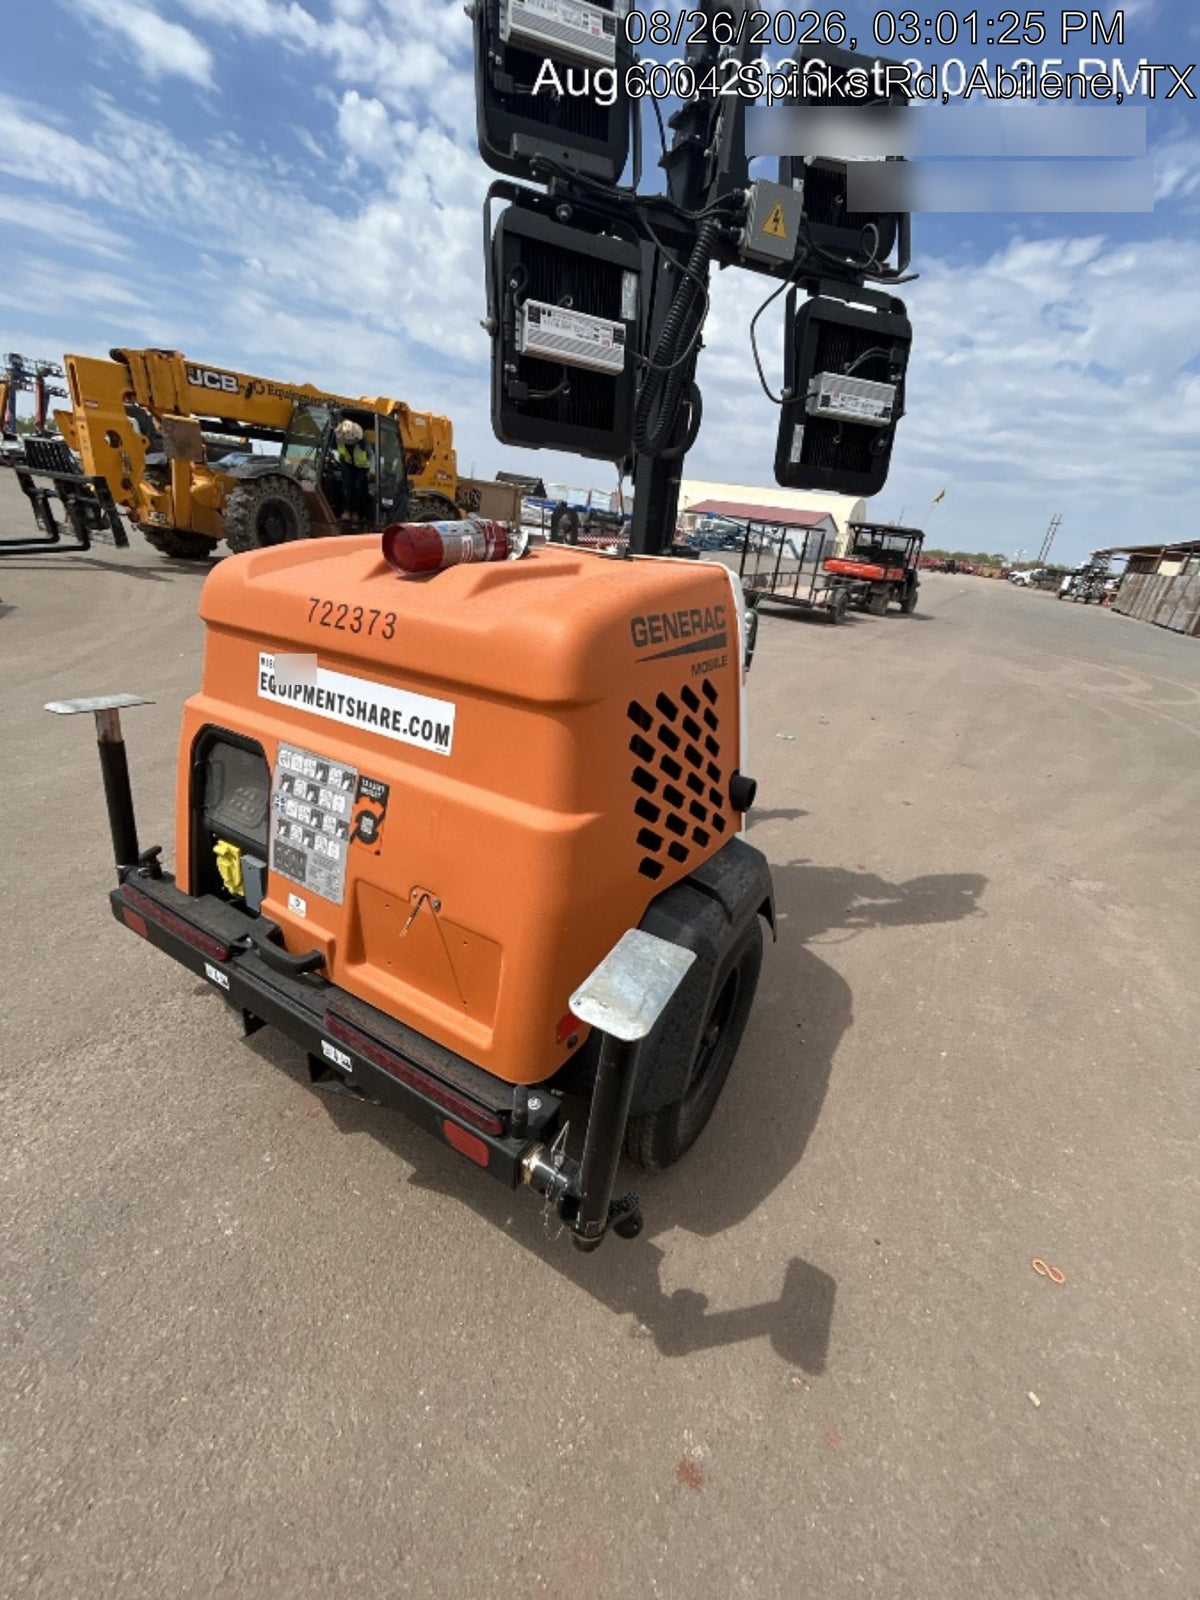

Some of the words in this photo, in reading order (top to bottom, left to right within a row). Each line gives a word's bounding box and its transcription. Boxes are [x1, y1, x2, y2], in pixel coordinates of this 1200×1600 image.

[187, 368, 238, 393] JCB
[307, 597, 397, 640] 722373
[630, 604, 727, 648] GENERAC
[690, 655, 728, 677] MOBILE
[260, 671, 451, 747] EQUIPMENTSHARE.COM
